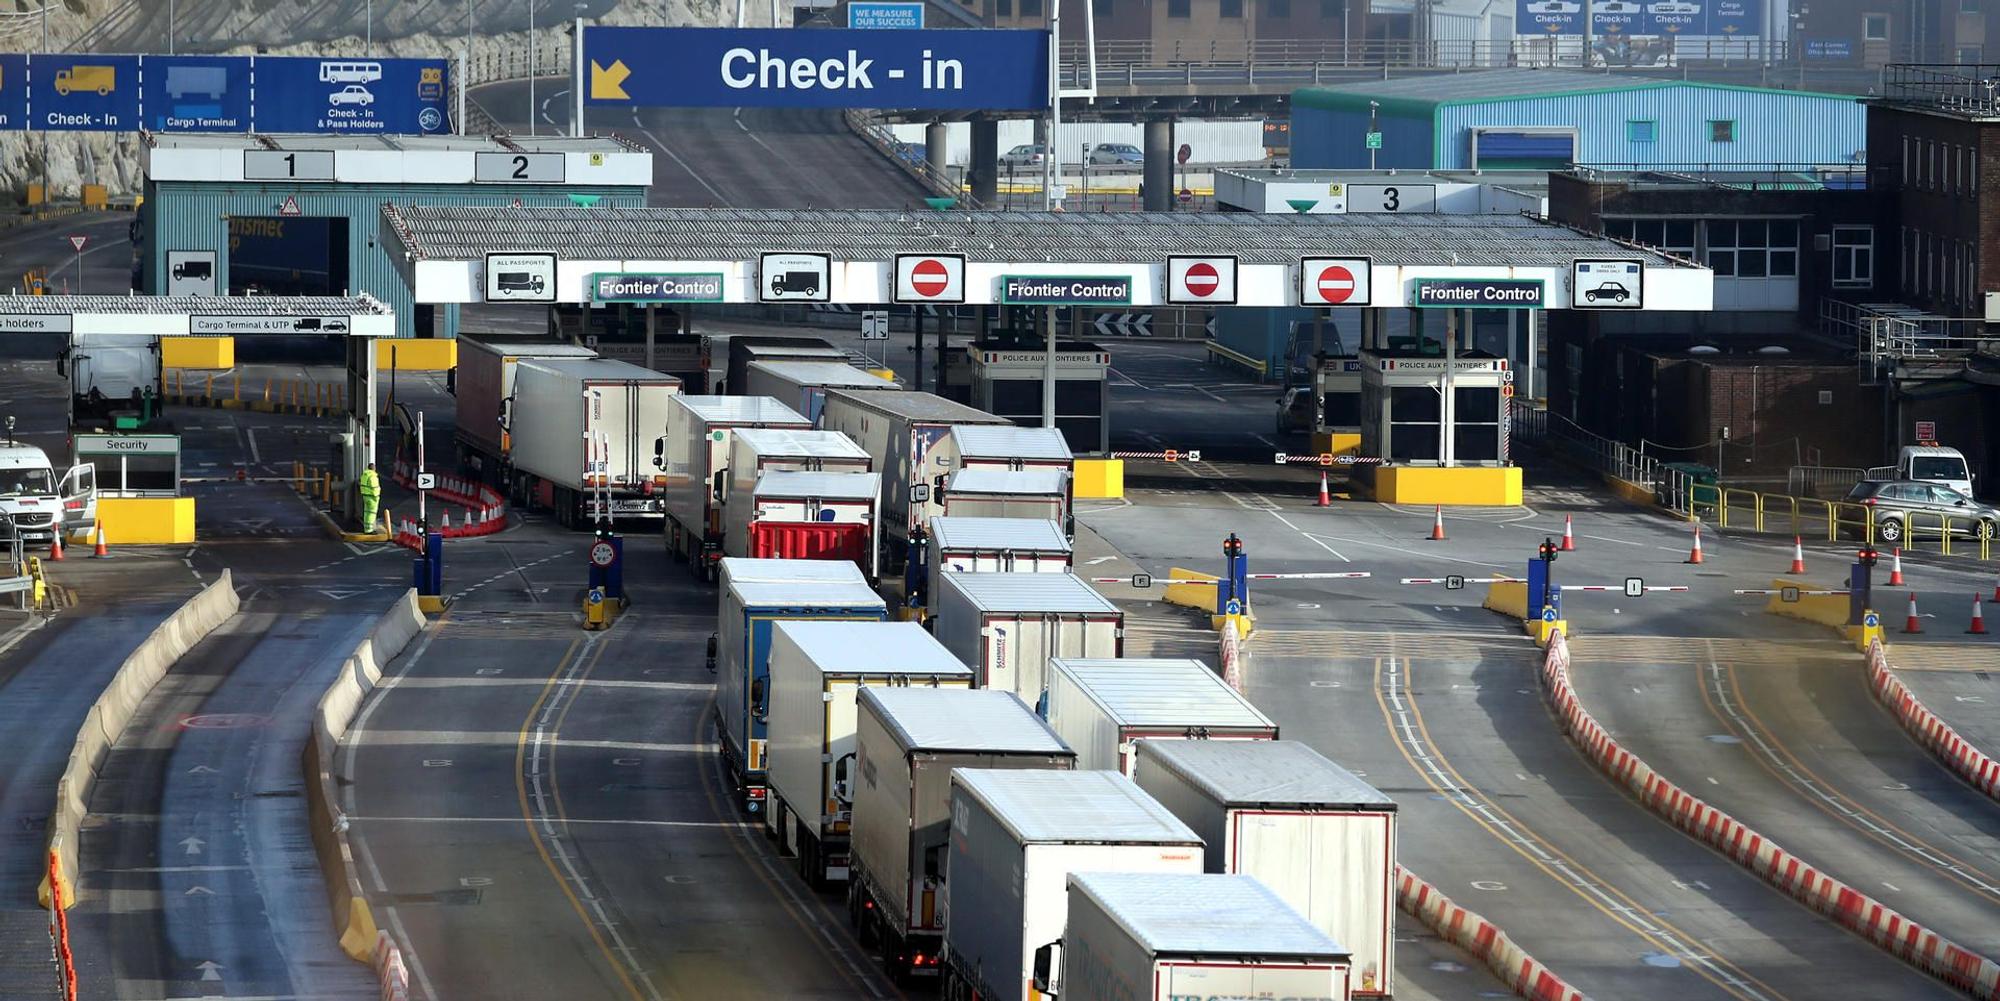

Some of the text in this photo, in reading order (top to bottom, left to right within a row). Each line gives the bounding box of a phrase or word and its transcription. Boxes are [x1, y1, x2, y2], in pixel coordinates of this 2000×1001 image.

[855, 18, 916, 26] OUR SUCCESS
[1535, 14, 1572, 23] Check-in
[1594, 14, 1632, 23] Check-in
[1655, 15, 1692, 24] Check-in
[721, 47, 874, 89] Check
[922, 49, 964, 89] in
[328, 109, 358, 117] Check
[365, 109, 374, 117] In
[47, 112, 93, 125] Check
[105, 113, 118, 125] In
[166, 117, 237, 129] Cargo Terminal
[326, 120, 348, 128] Pass
[350, 119, 384, 128] Holders
[284, 153, 295, 177] 1
[512, 155, 529, 179] 2
[1383, 187, 1399, 211] 3
[600, 280, 718, 295] Frontier Control
[1008, 282, 1127, 298] Frontier Control
[1421, 285, 1540, 301] Frontier Control
[4, 318, 44, 328] holders
[198, 320, 289, 330] Cargo Terminal & UTP
[1002, 354, 1029, 362] POLICE
[1030, 354, 1045, 362] AUX
[1445, 362, 1488, 370] FONTIERES
[1505, 371, 1511, 380] 6
[107, 439, 148, 451] Security
[422, 477, 430, 485] A
